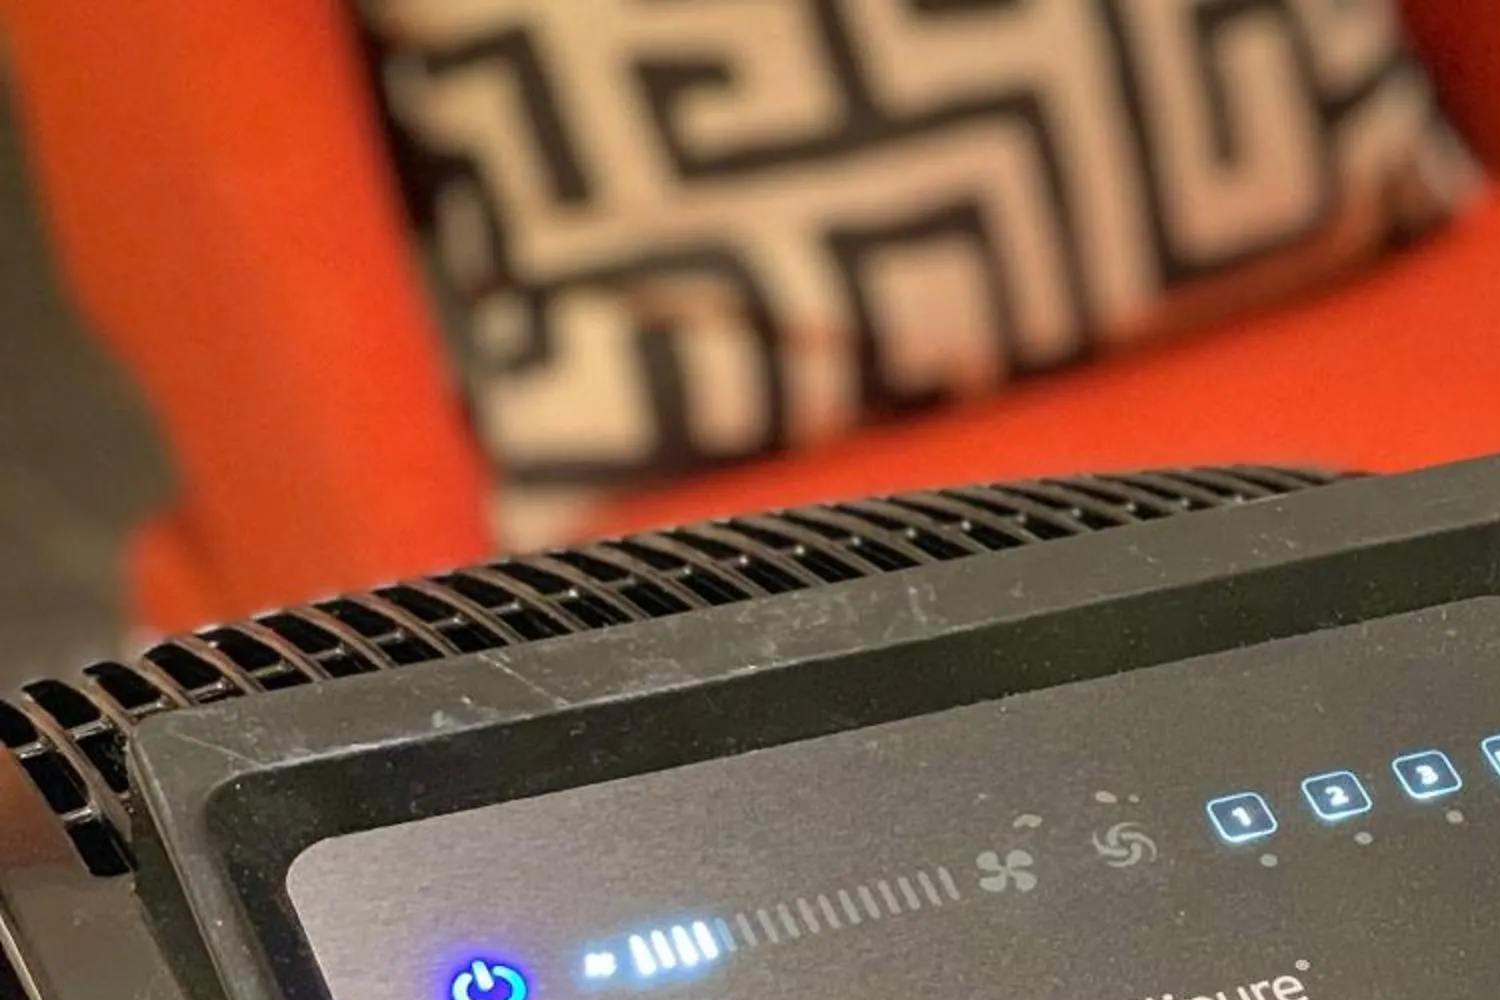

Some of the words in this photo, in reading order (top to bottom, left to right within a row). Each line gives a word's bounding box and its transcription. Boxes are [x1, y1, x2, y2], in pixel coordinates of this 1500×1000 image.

[1232, 807, 1251, 827] 1
[1325, 786, 1349, 805] 2
[1415, 765, 1438, 785] 3
